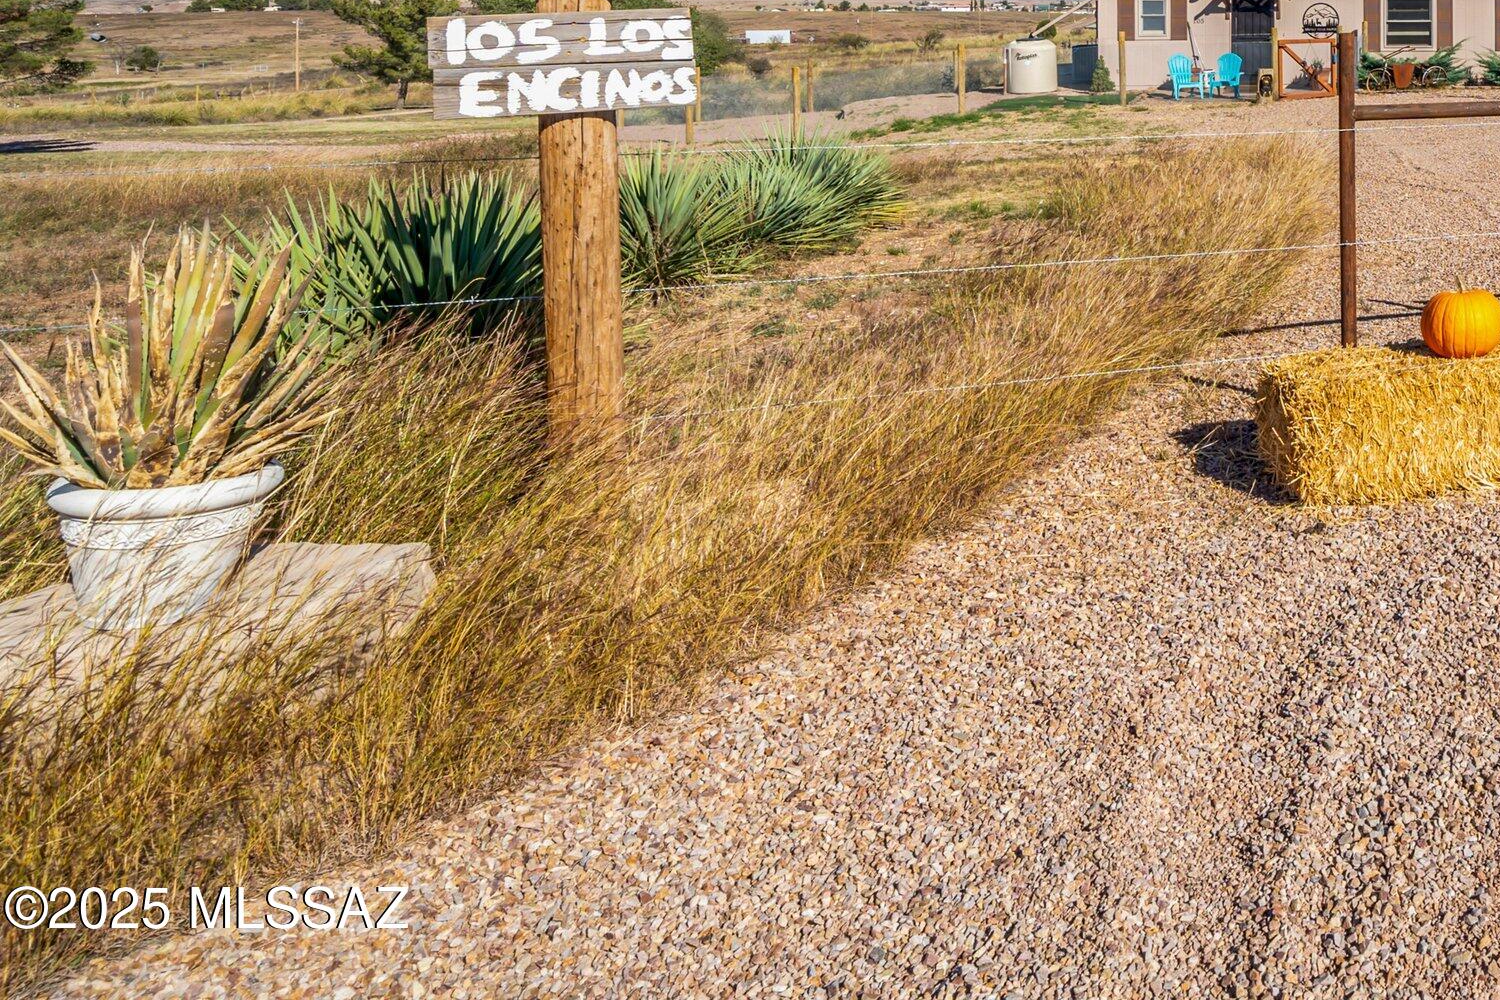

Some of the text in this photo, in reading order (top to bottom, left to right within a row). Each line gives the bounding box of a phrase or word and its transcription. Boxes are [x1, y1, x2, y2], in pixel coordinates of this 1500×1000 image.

[445, 16, 693, 65] 105 LOS
[458, 67, 698, 117] ENCINOS
